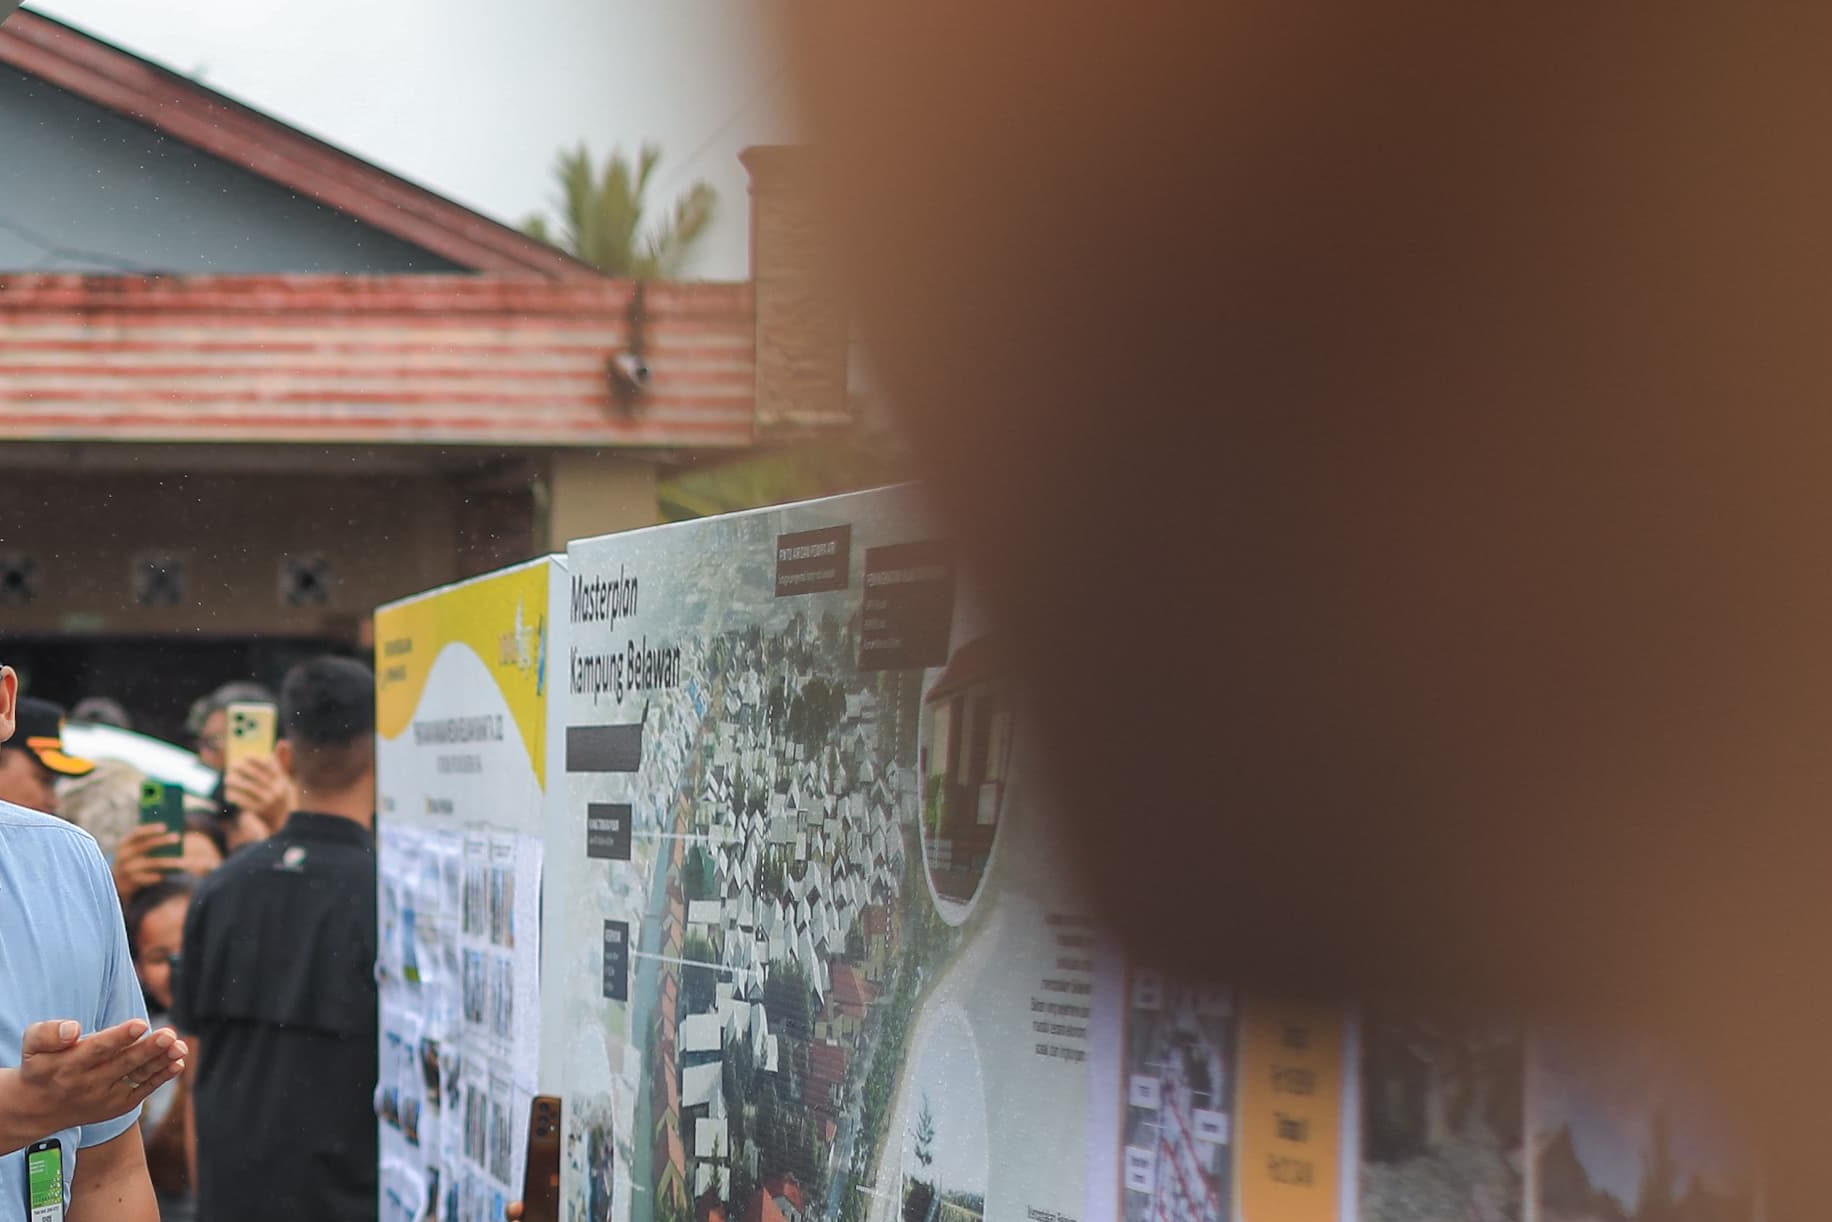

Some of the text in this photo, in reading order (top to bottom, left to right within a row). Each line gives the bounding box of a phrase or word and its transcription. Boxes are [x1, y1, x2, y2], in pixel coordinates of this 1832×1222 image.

[570, 563, 638, 631] Masterplan
[570, 634, 680, 705] Kampung Belawan
